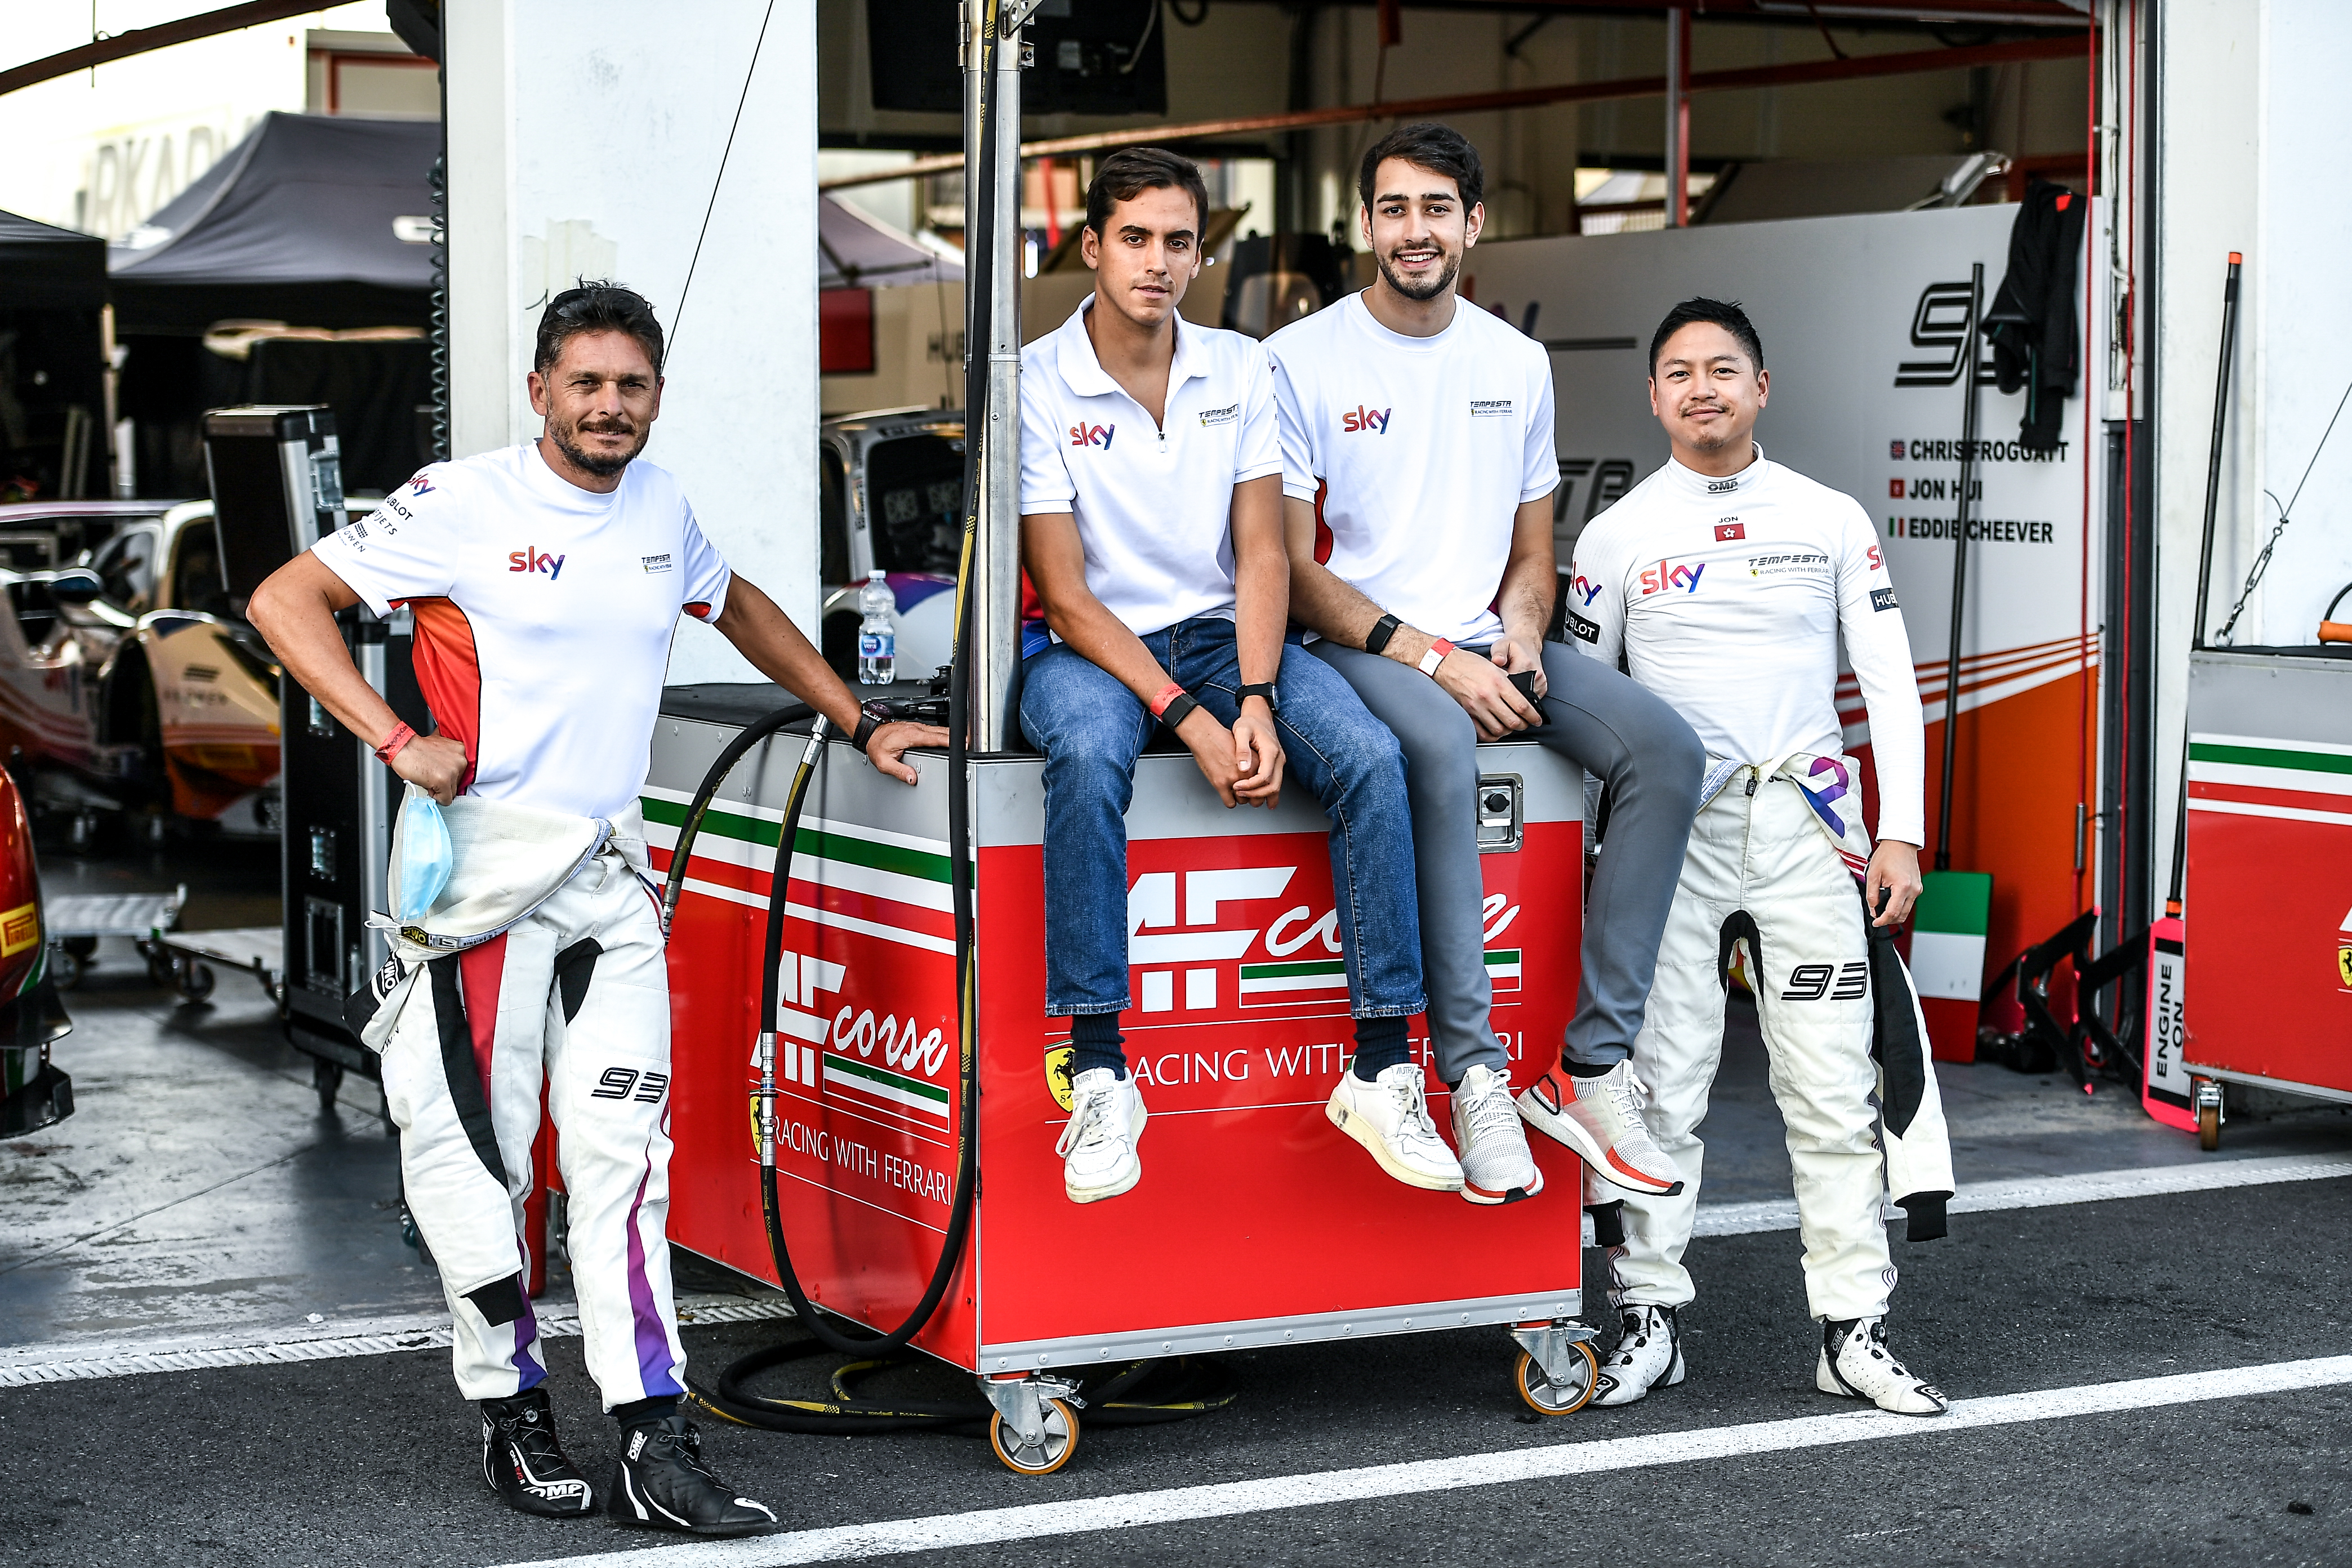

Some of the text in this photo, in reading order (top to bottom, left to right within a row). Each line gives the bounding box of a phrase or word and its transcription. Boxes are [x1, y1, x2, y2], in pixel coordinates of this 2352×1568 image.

[1199, 403, 1239, 418] TEMPEST
[1343, 405, 1391, 435] sky
[1070, 416, 1115, 450] sky
[1708, 480, 1738, 491] OMP
[1910, 480, 1944, 500] JON
[373, 508, 398, 535] TJETS
[386, 496, 413, 520] UBLOT
[1909, 518, 2052, 544] EDDIE CHEEVER
[509, 546, 565, 580] sky
[642, 554, 670, 564] TEMPESTA
[1748, 554, 1829, 567] TEMPESTA
[1571, 561, 1602, 607] ky
[1640, 560, 1705, 595] sky
[1874, 594, 1898, 608] HUB
[1565, 612, 1595, 638] UBLOT
[1781, 961, 1868, 1000] 93
[2157, 964, 2172, 1078] ENGINE
[2172, 1001, 2184, 1049] ON
[833, 1005, 949, 1077] corse
[1076, 1072, 1092, 1086] AUTRY
[1131, 1048, 1249, 1086] ACING
[591, 1067, 669, 1104] 93
[774, 1116, 951, 1206] RACING WITH FERRARI
[1832, 1329, 1845, 1352] OMP
[630, 1431, 644, 1460] OMP
